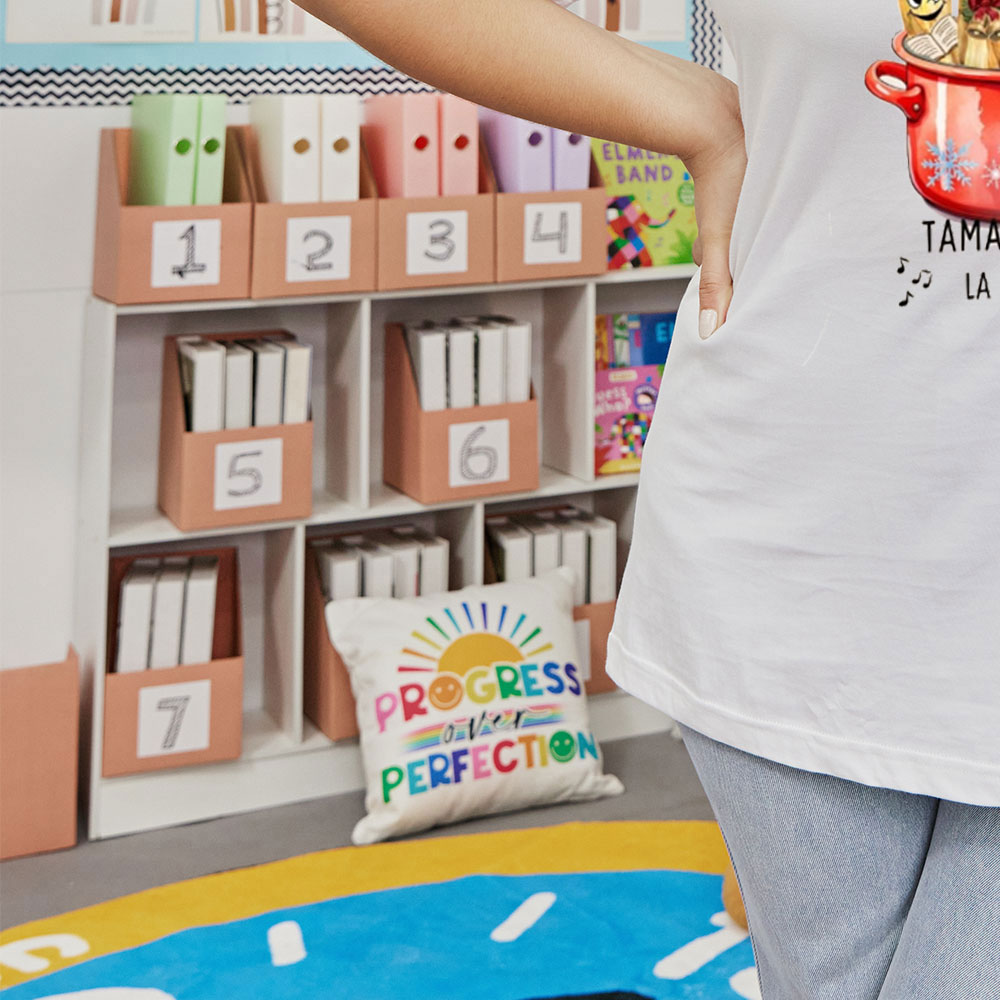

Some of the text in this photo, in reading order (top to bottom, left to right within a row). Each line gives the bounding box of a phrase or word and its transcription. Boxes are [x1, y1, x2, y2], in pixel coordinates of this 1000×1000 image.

[616, 165, 673, 184] BAND
[171, 224, 206, 279] 1
[296, 229, 335, 272] 2
[424, 219, 457, 262] 3
[531, 211, 569, 254] 4
[965, 271, 992, 300] LA
[226, 450, 264, 497] 5
[460, 425, 499, 482] 6
[375, 661, 582, 734] PROGRESS
[156, 694, 192, 750] 7
[441, 708, 528, 744] over
[381, 730, 600, 804] PERFECTION
